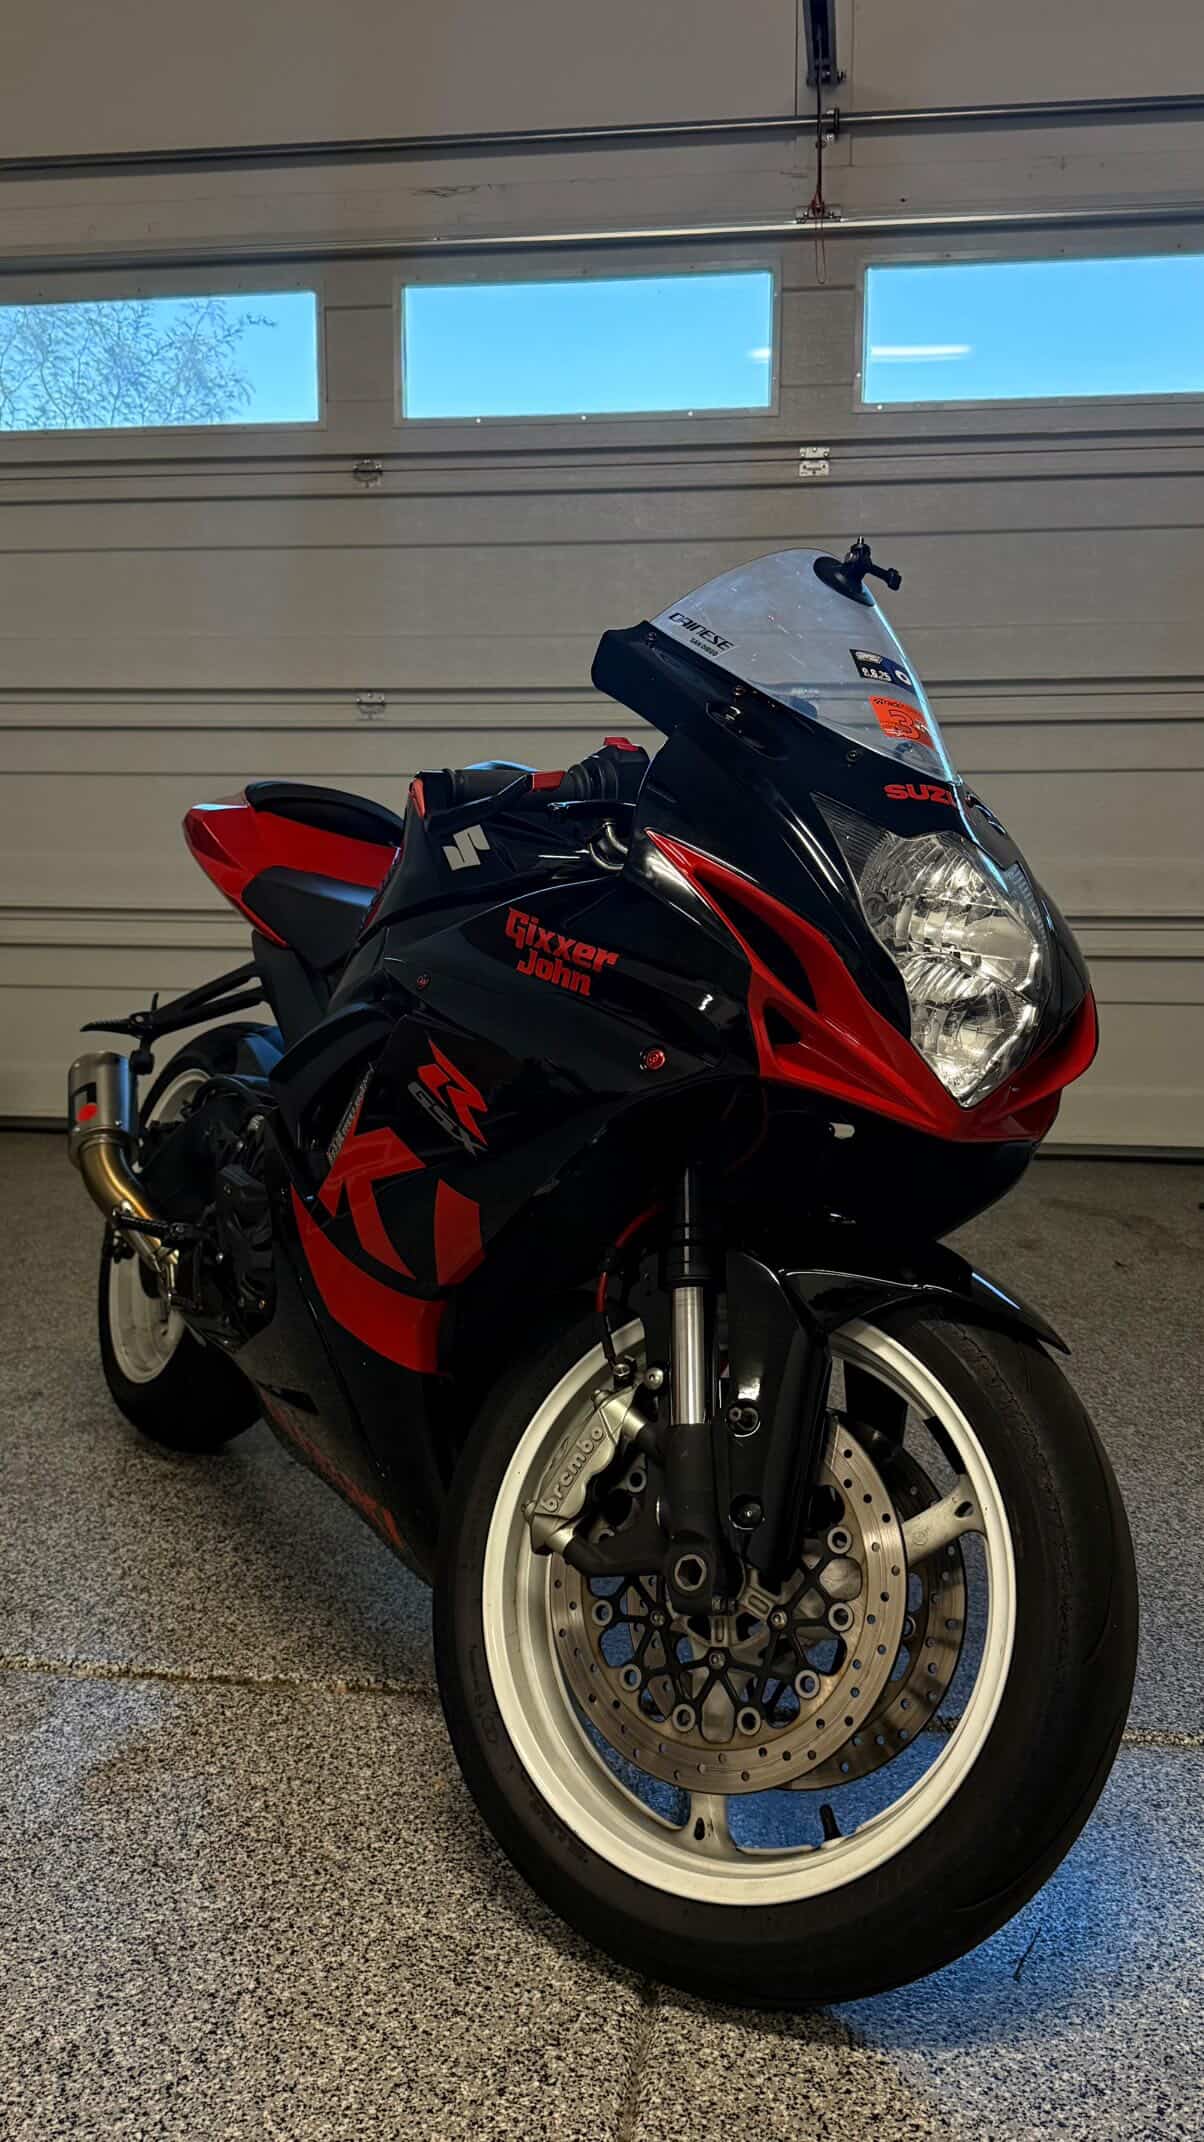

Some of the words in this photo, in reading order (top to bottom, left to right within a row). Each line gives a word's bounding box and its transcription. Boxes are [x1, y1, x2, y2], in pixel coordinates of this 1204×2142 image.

[504, 906, 619, 972] Gixxer
[516, 948, 590, 996] John
[541, 1427, 604, 1513] brembo
